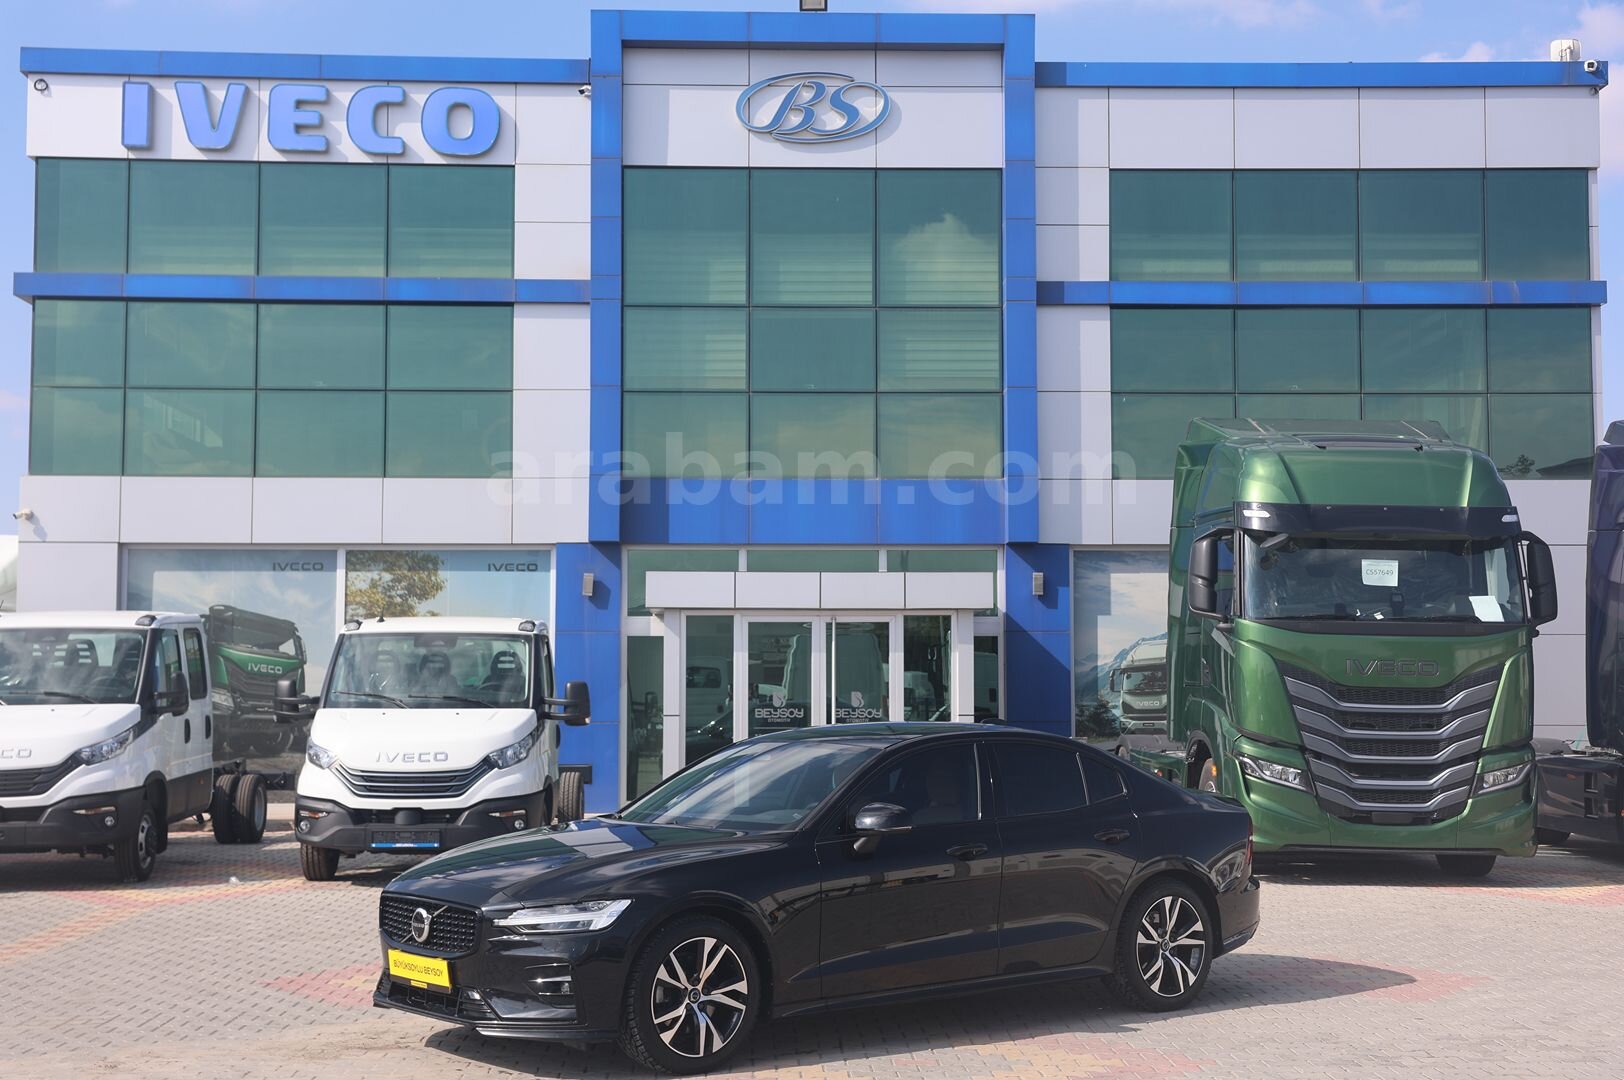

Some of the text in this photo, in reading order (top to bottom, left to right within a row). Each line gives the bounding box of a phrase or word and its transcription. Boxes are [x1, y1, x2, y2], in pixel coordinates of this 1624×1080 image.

[121, 81, 501, 157] IVECO
[272, 561, 324, 572] IVECO
[487, 562, 538, 573] IVECO
[248, 661, 283, 675] IVECO
[1345, 658, 1441, 678] IVECO
[754, 708, 804, 719] BEYSOY
[376, 751, 449, 764] IVECO
[423, 965, 444, 976] BEYSOY
